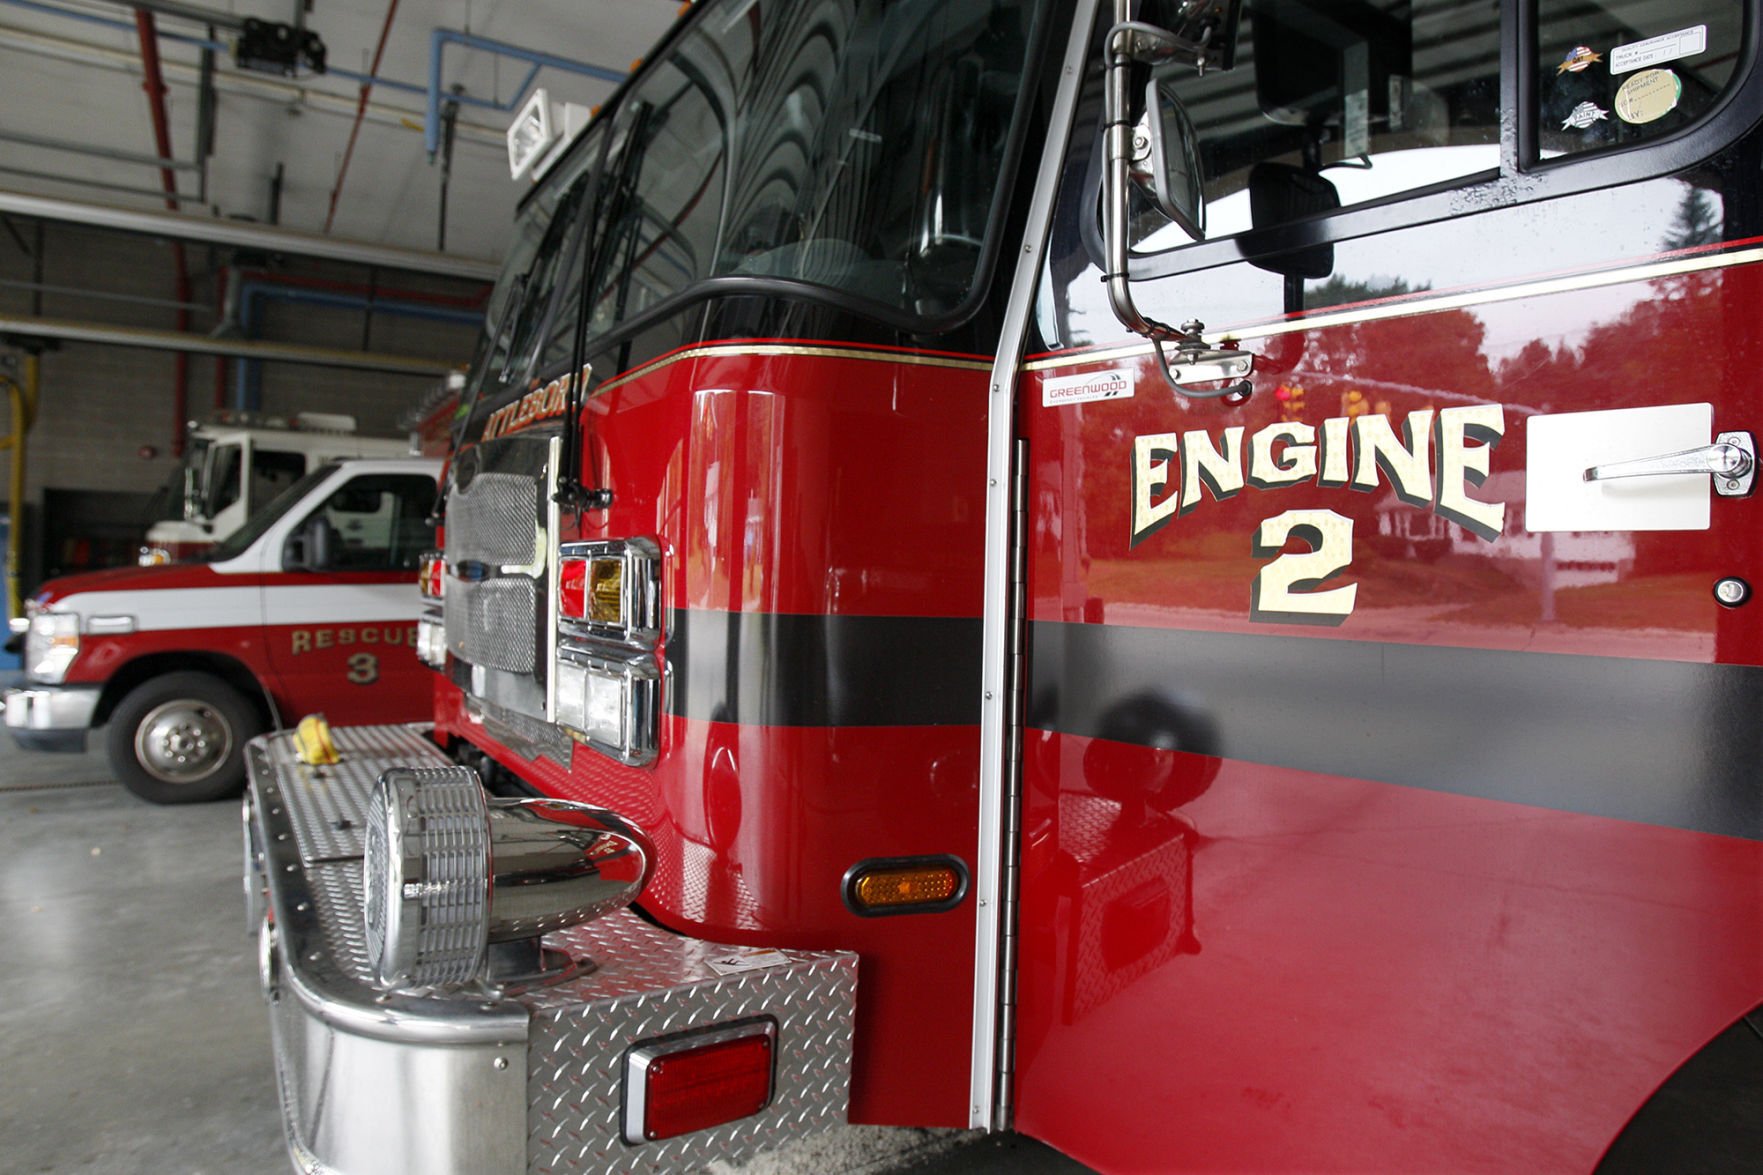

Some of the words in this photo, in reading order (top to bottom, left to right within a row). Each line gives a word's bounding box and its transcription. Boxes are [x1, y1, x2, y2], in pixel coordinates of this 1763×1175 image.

[1050, 380, 1127, 398] GREENWOOD
[1130, 403, 1505, 551] ENGINE
[1249, 508, 1358, 627] 2
[291, 627, 418, 655] RESCUE
[347, 652, 379, 685] 3
